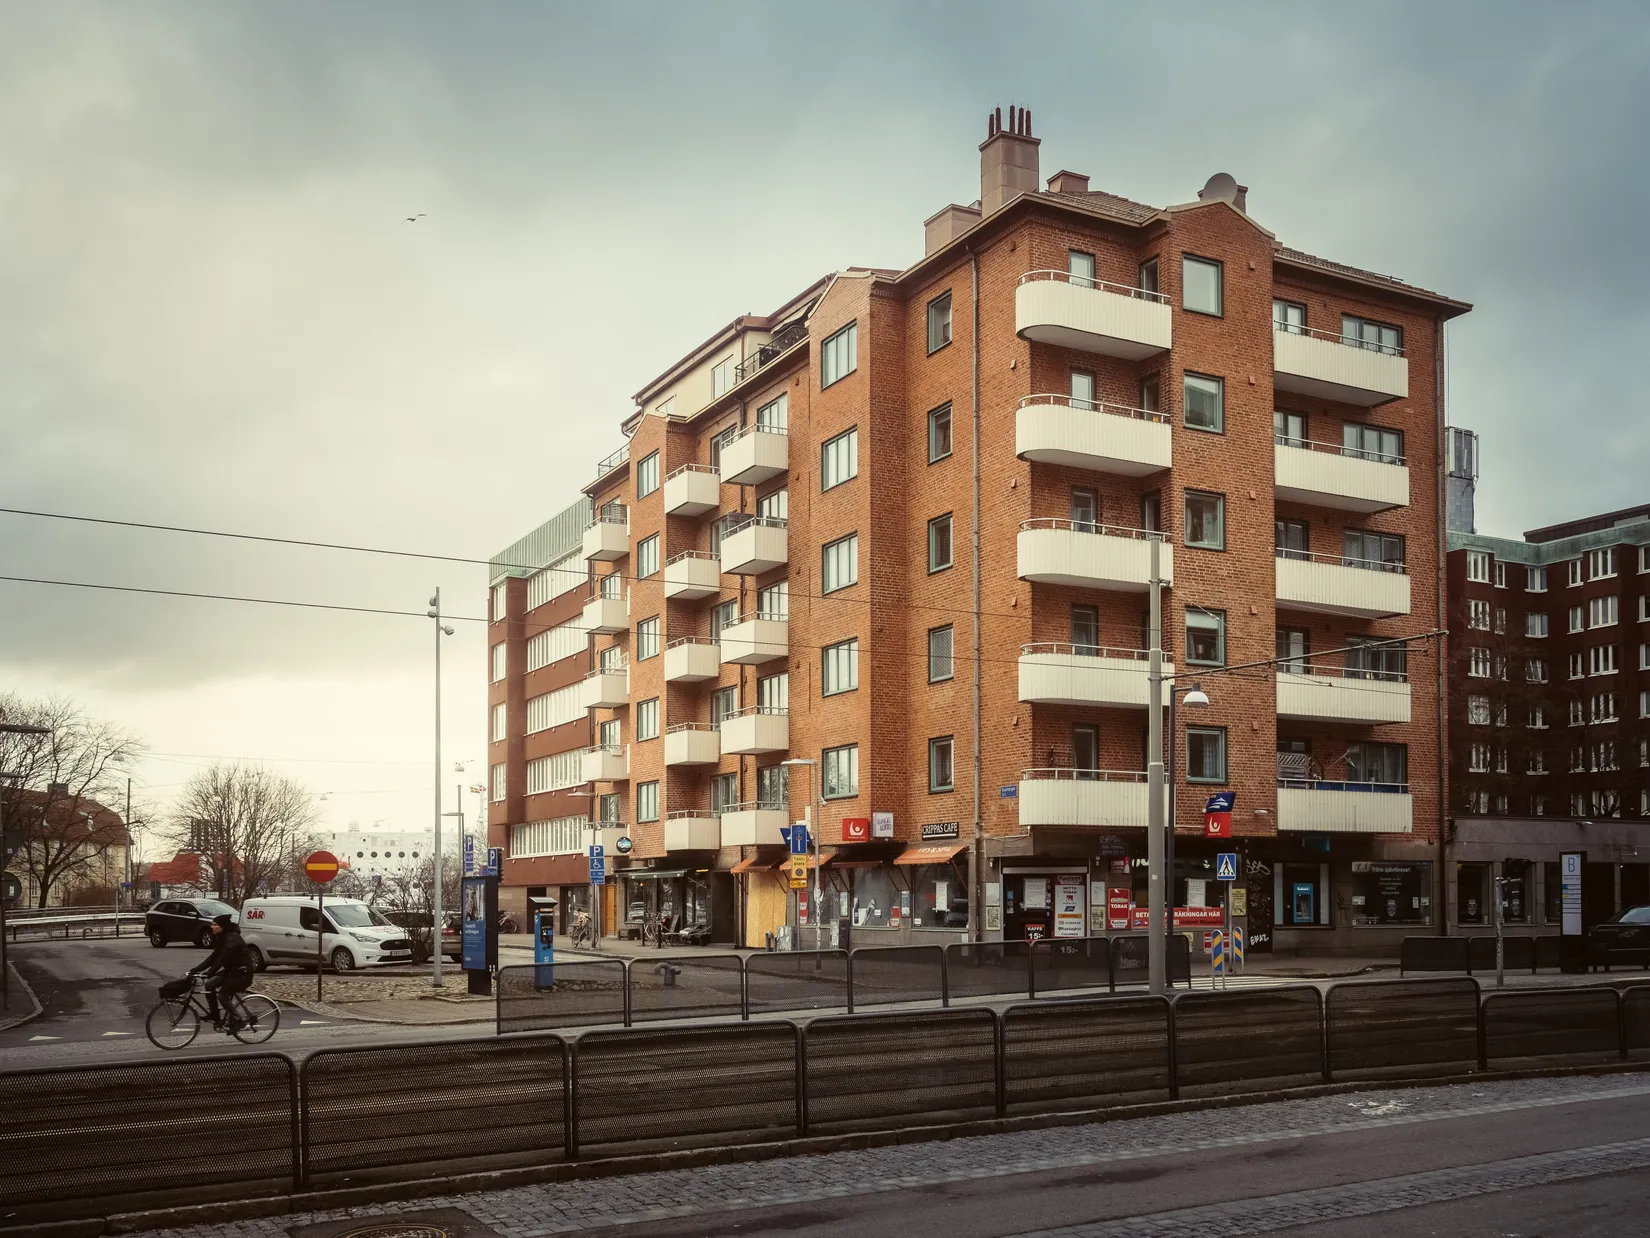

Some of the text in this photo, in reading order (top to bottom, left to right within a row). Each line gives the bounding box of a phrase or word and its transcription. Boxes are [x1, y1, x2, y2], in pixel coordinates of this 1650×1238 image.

[922, 824, 943, 834] CRIPPAS
[467, 836, 472, 850] P
[594, 846, 601, 856] P
[490, 850, 495, 865] P
[1568, 857, 1576, 872] B
[1174, 910, 1207, 918] RÄKNINGAR
[1208, 909, 1221, 917] HÄR
[1060, 946, 1079, 954] 15:-
